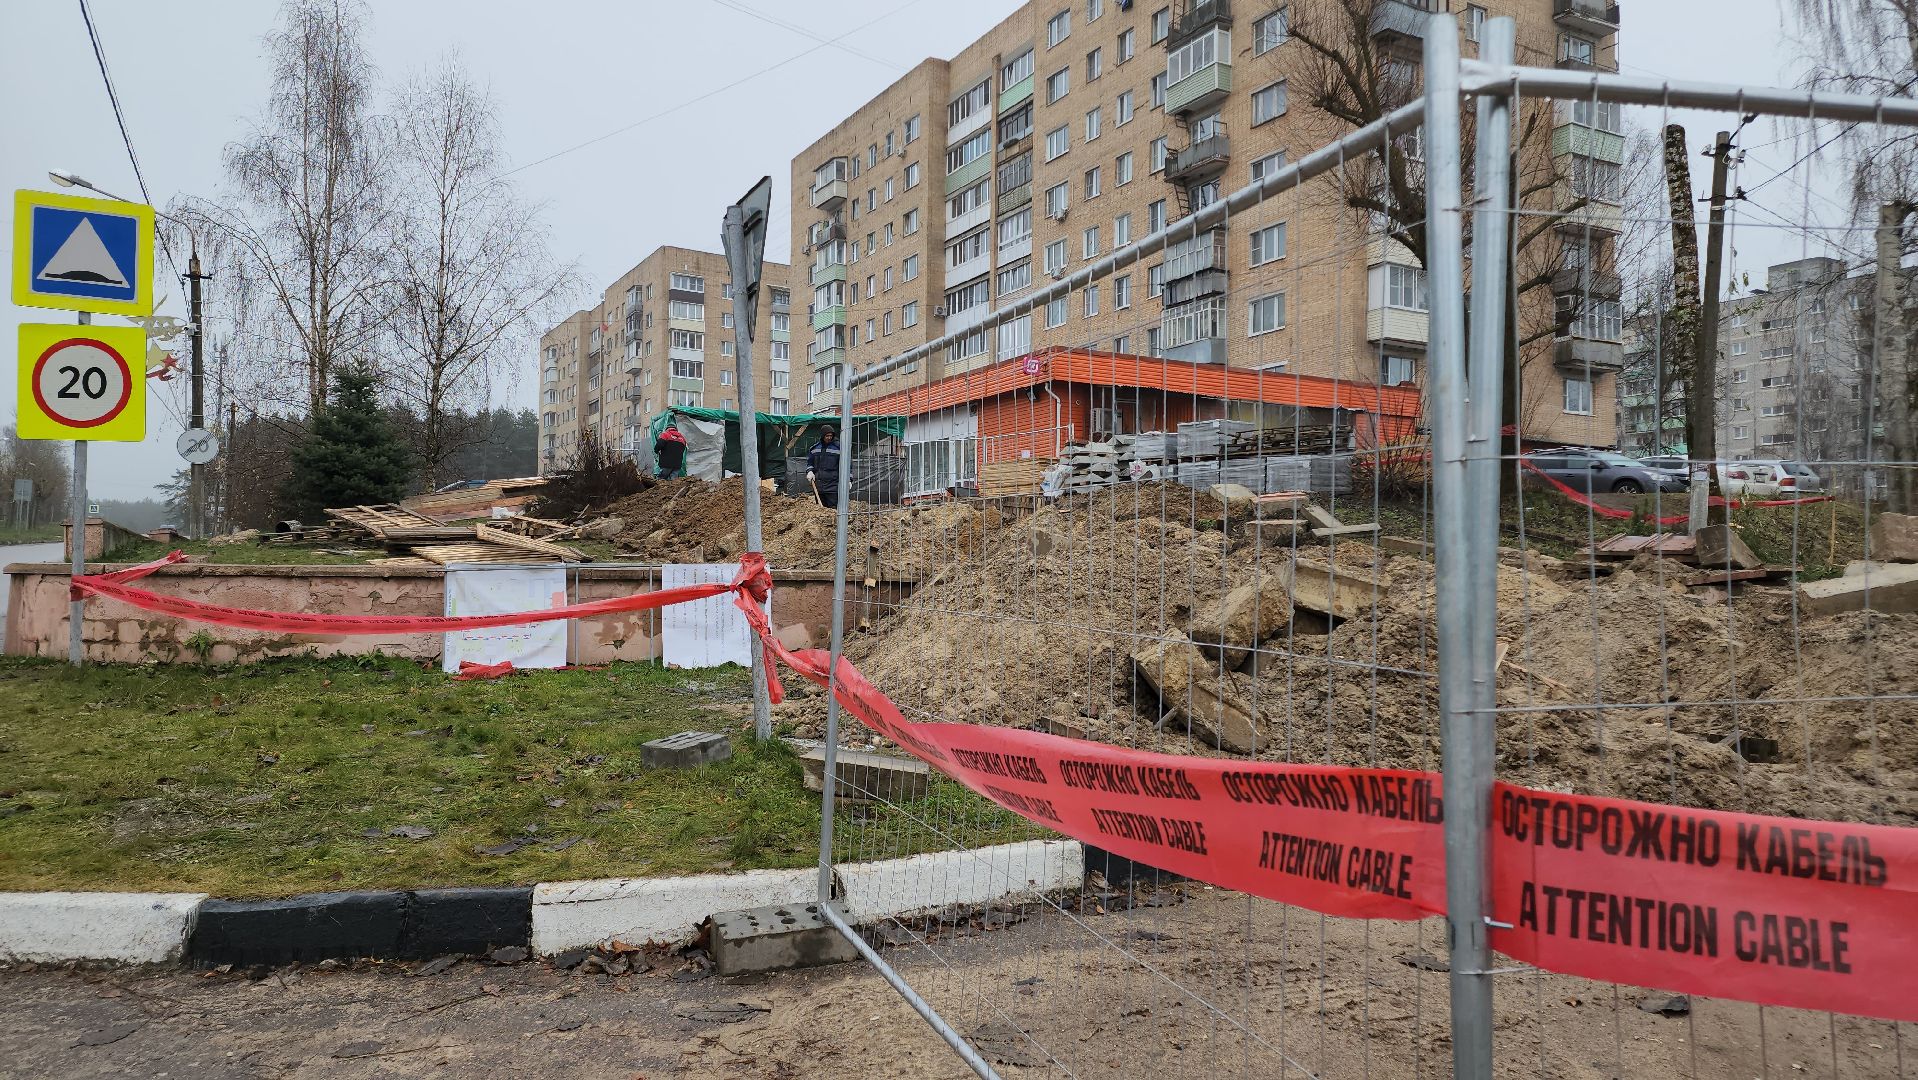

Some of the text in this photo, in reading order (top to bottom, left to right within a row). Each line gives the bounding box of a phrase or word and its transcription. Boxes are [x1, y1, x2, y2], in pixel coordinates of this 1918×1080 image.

[57, 365, 107, 400] 20
[951, 748, 1047, 784] ОСТОРОЖНО КАБЕЛЬ
[1059, 759, 1201, 801] ОСТОРОЖНО КАБЕЛЬ
[1221, 771, 1444, 824] ОСТОРОЖНО КАБЕЛЬ
[1091, 808, 1208, 856] ATTENTION CABLE
[1502, 790, 1888, 886] ОСТОРОЖНО КАБЕЛЬ
[1259, 831, 1413, 900] ATTENTION CABLE
[1519, 881, 1853, 975] ATTENTION CABLE
